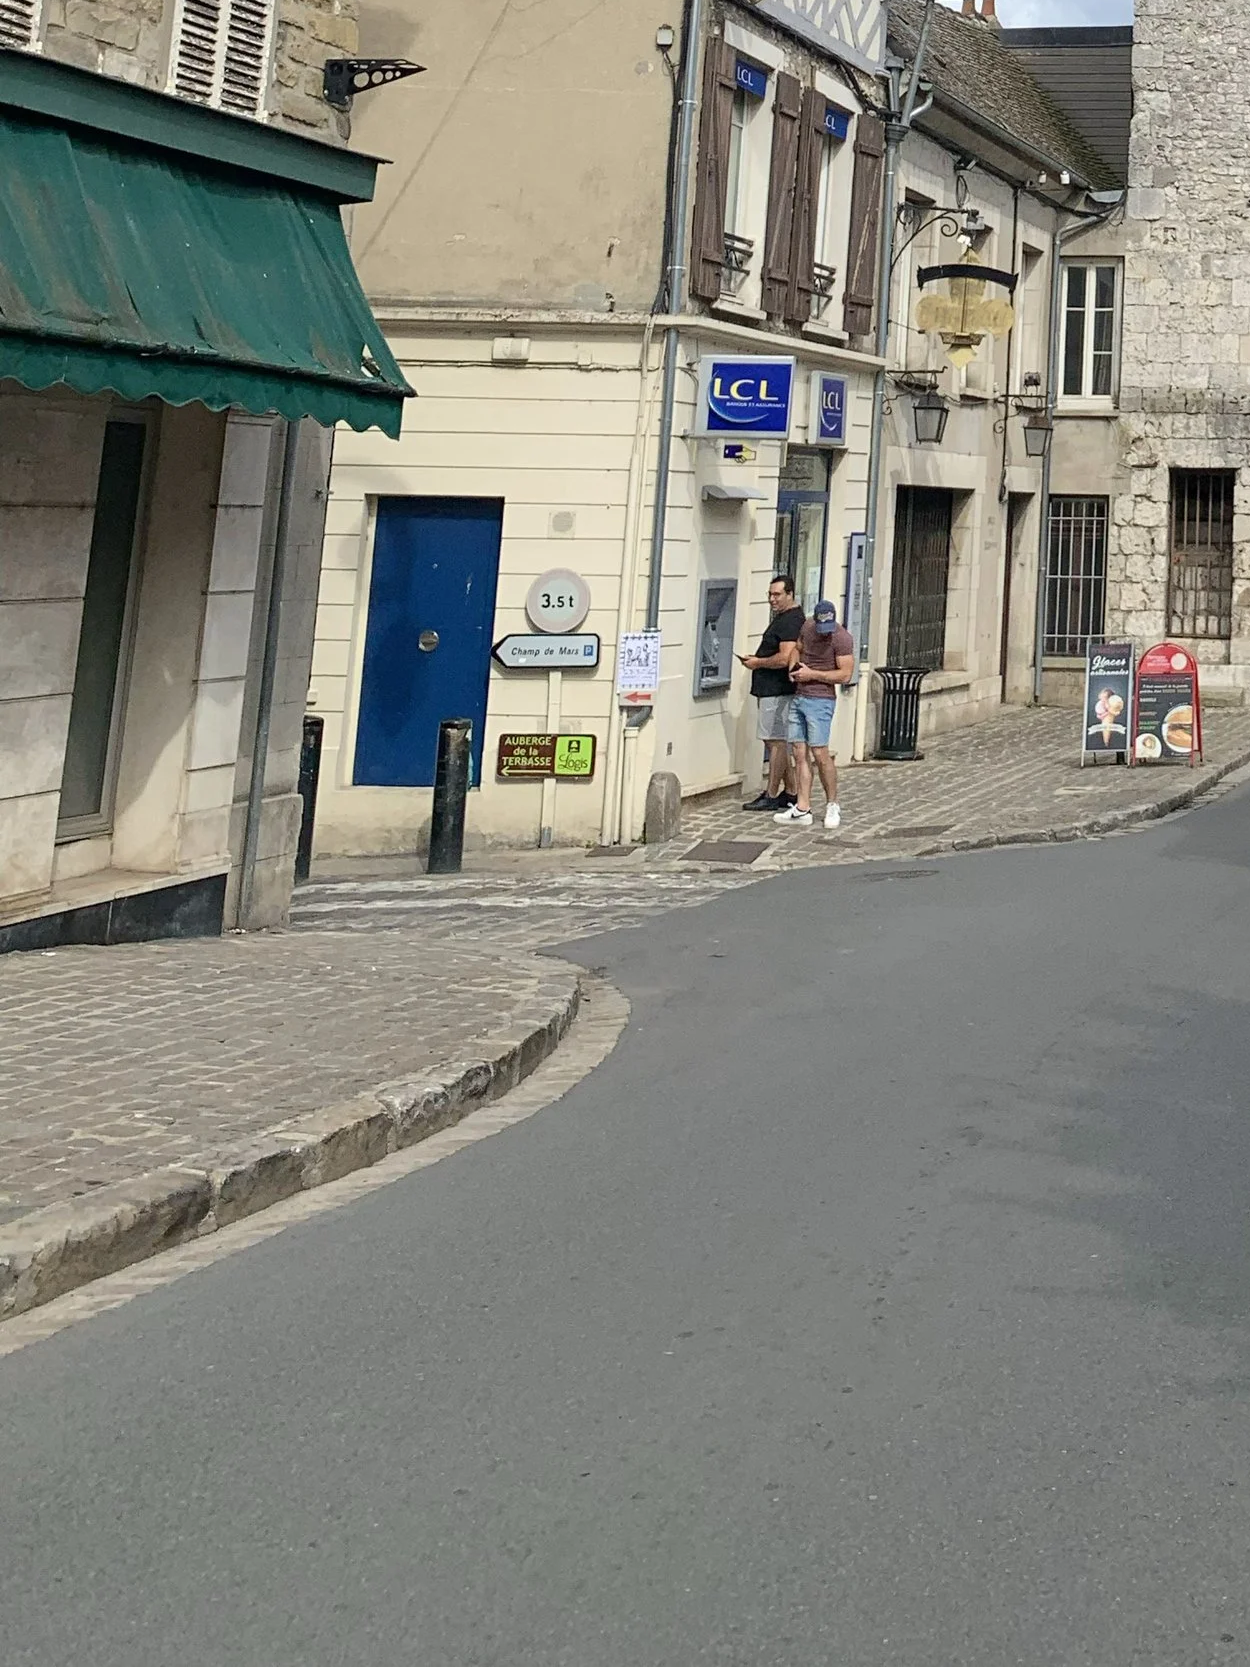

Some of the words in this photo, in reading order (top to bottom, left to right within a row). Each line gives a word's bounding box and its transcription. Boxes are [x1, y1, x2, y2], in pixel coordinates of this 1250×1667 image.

[737, 65, 754, 86] LCL
[824, 114, 836, 130] CL
[713, 378, 779, 401] LCL
[823, 391, 841, 410] LCL
[511, 646, 540, 658] Champ
[544, 647, 555, 656] de
[558, 646, 579, 656] Mars
[504, 736, 552, 746] AUBERGE
[513, 746, 527, 756] de
[529, 746, 539, 756] la
[558, 752, 588, 772] Logis
